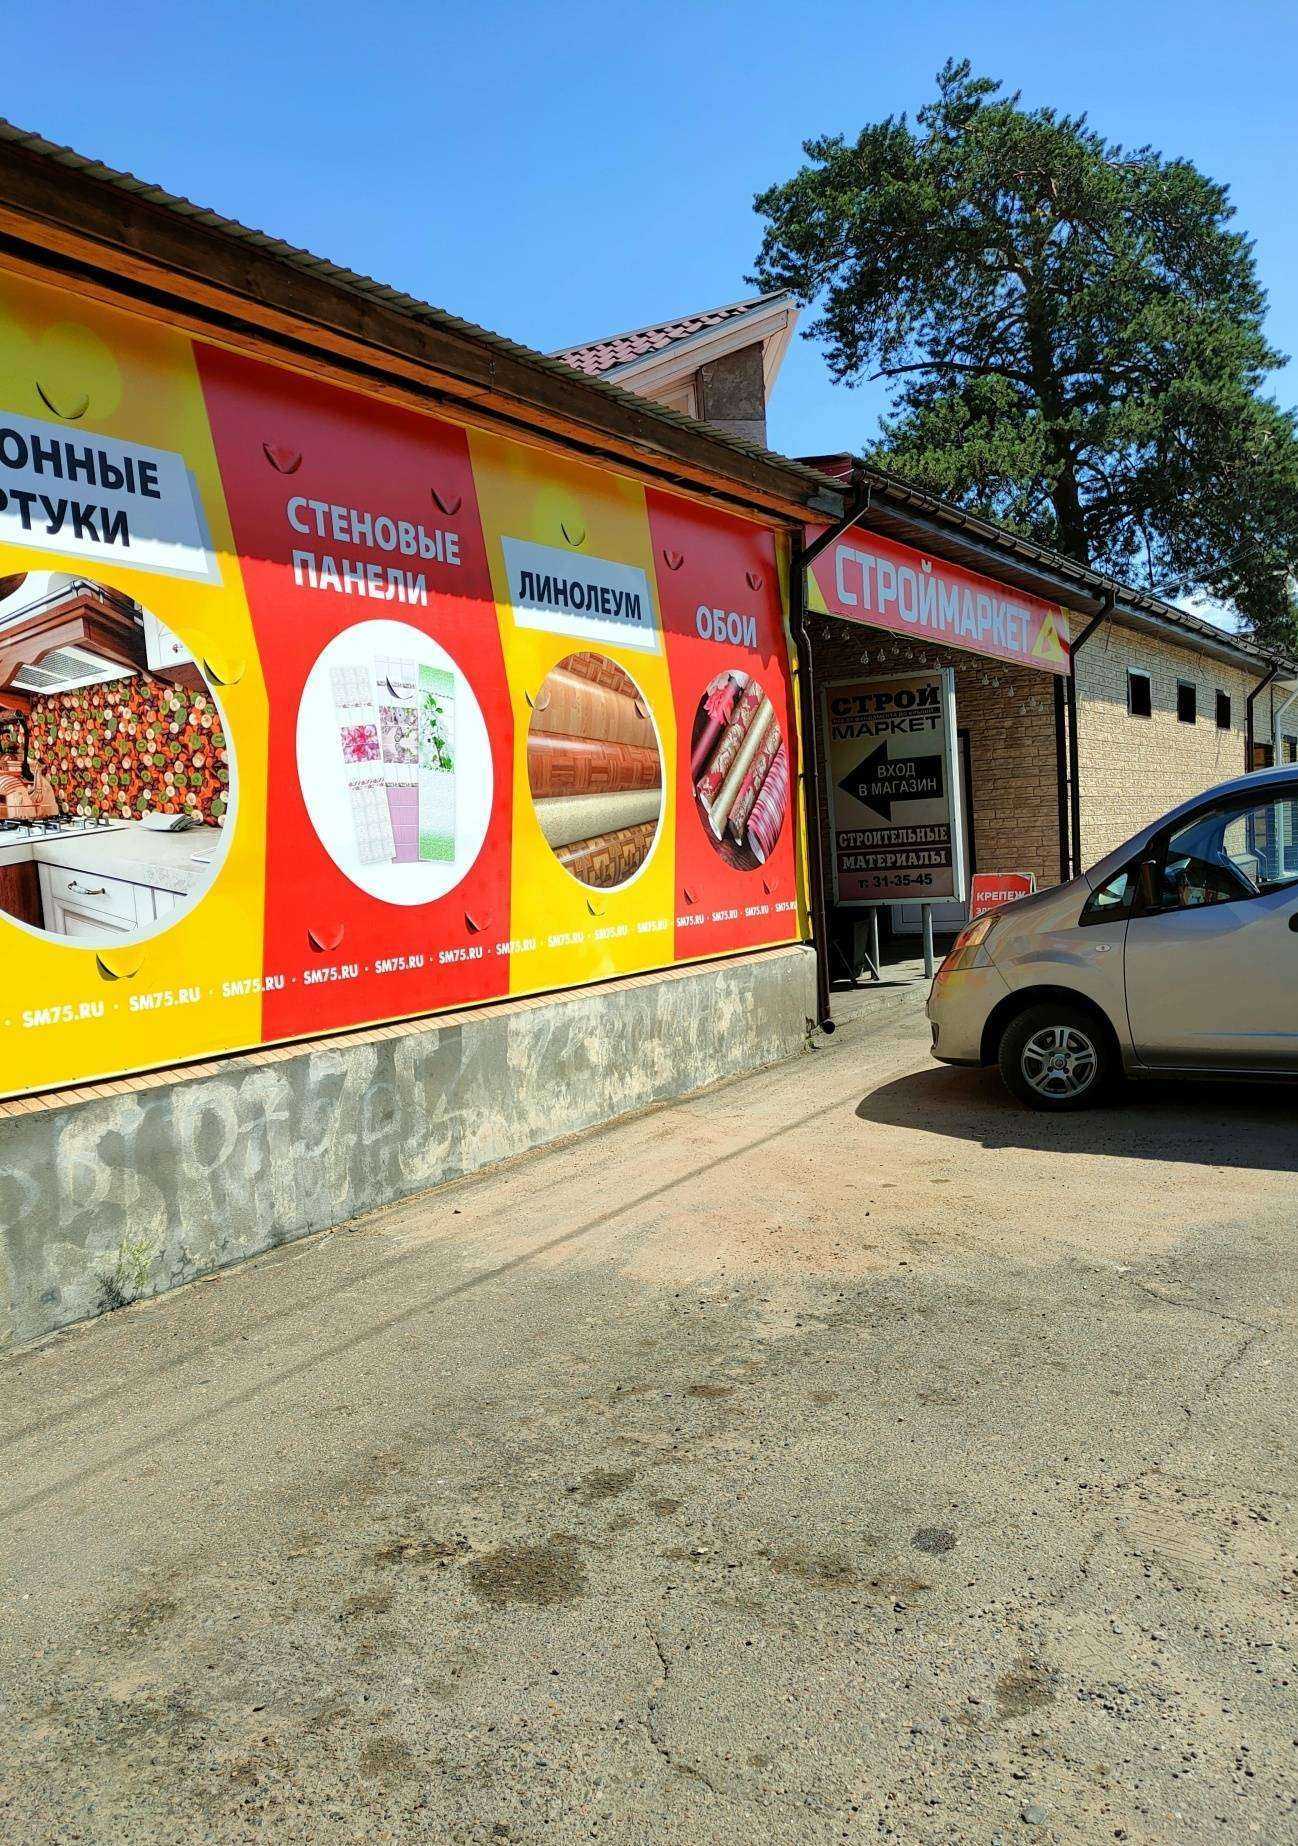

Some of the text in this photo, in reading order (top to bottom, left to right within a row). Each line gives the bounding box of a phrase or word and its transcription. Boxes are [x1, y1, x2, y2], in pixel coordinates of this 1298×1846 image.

[0, 427, 161, 499] ОННЫЕ
[286, 496, 461, 566] СТЕНОВЫЕ
[292, 549, 428, 607] ПАНЕЛИ
[518, 569, 642, 621] ЛИНОЛЕУМ
[834, 544, 1032, 652] СТРОЙМАРКЕТ
[695, 605, 758, 648] ОБОИ
[832, 683, 941, 716] СТРОЙ
[832, 715, 942, 740] МАРКЕТ
[858, 777, 937, 797] В МАГАЗИН
[877, 762, 916, 779] ВХОД
[839, 826, 948, 847] СТРОИТЕЛЬНЫЕ
[842, 850, 946, 871] МАТЕРИАЛЫ
[873, 873, 933, 888] 31-35-45
[976, 890, 1026, 901] КРЕПЕЖ
[22, 1001, 104, 1030] SM75.RU
[129, 987, 200, 1012] SM75.RU
[222, 975, 285, 998] SM75.RU
[303, 963, 358, 985] SM75.RU
[375, 954, 424, 974] SM75.RU
[438, 946, 483, 964] SM75.RU
[495, 938, 536, 955] SM75.RU
[547, 931, 584, 948] SM75.RU
[595, 924, 628, 941] SM75.RU
[637, 919, 667, 934] SM75.RU
[676, 913, 704, 928] SM75.RU
[712, 908, 738, 922] SM75.RU
